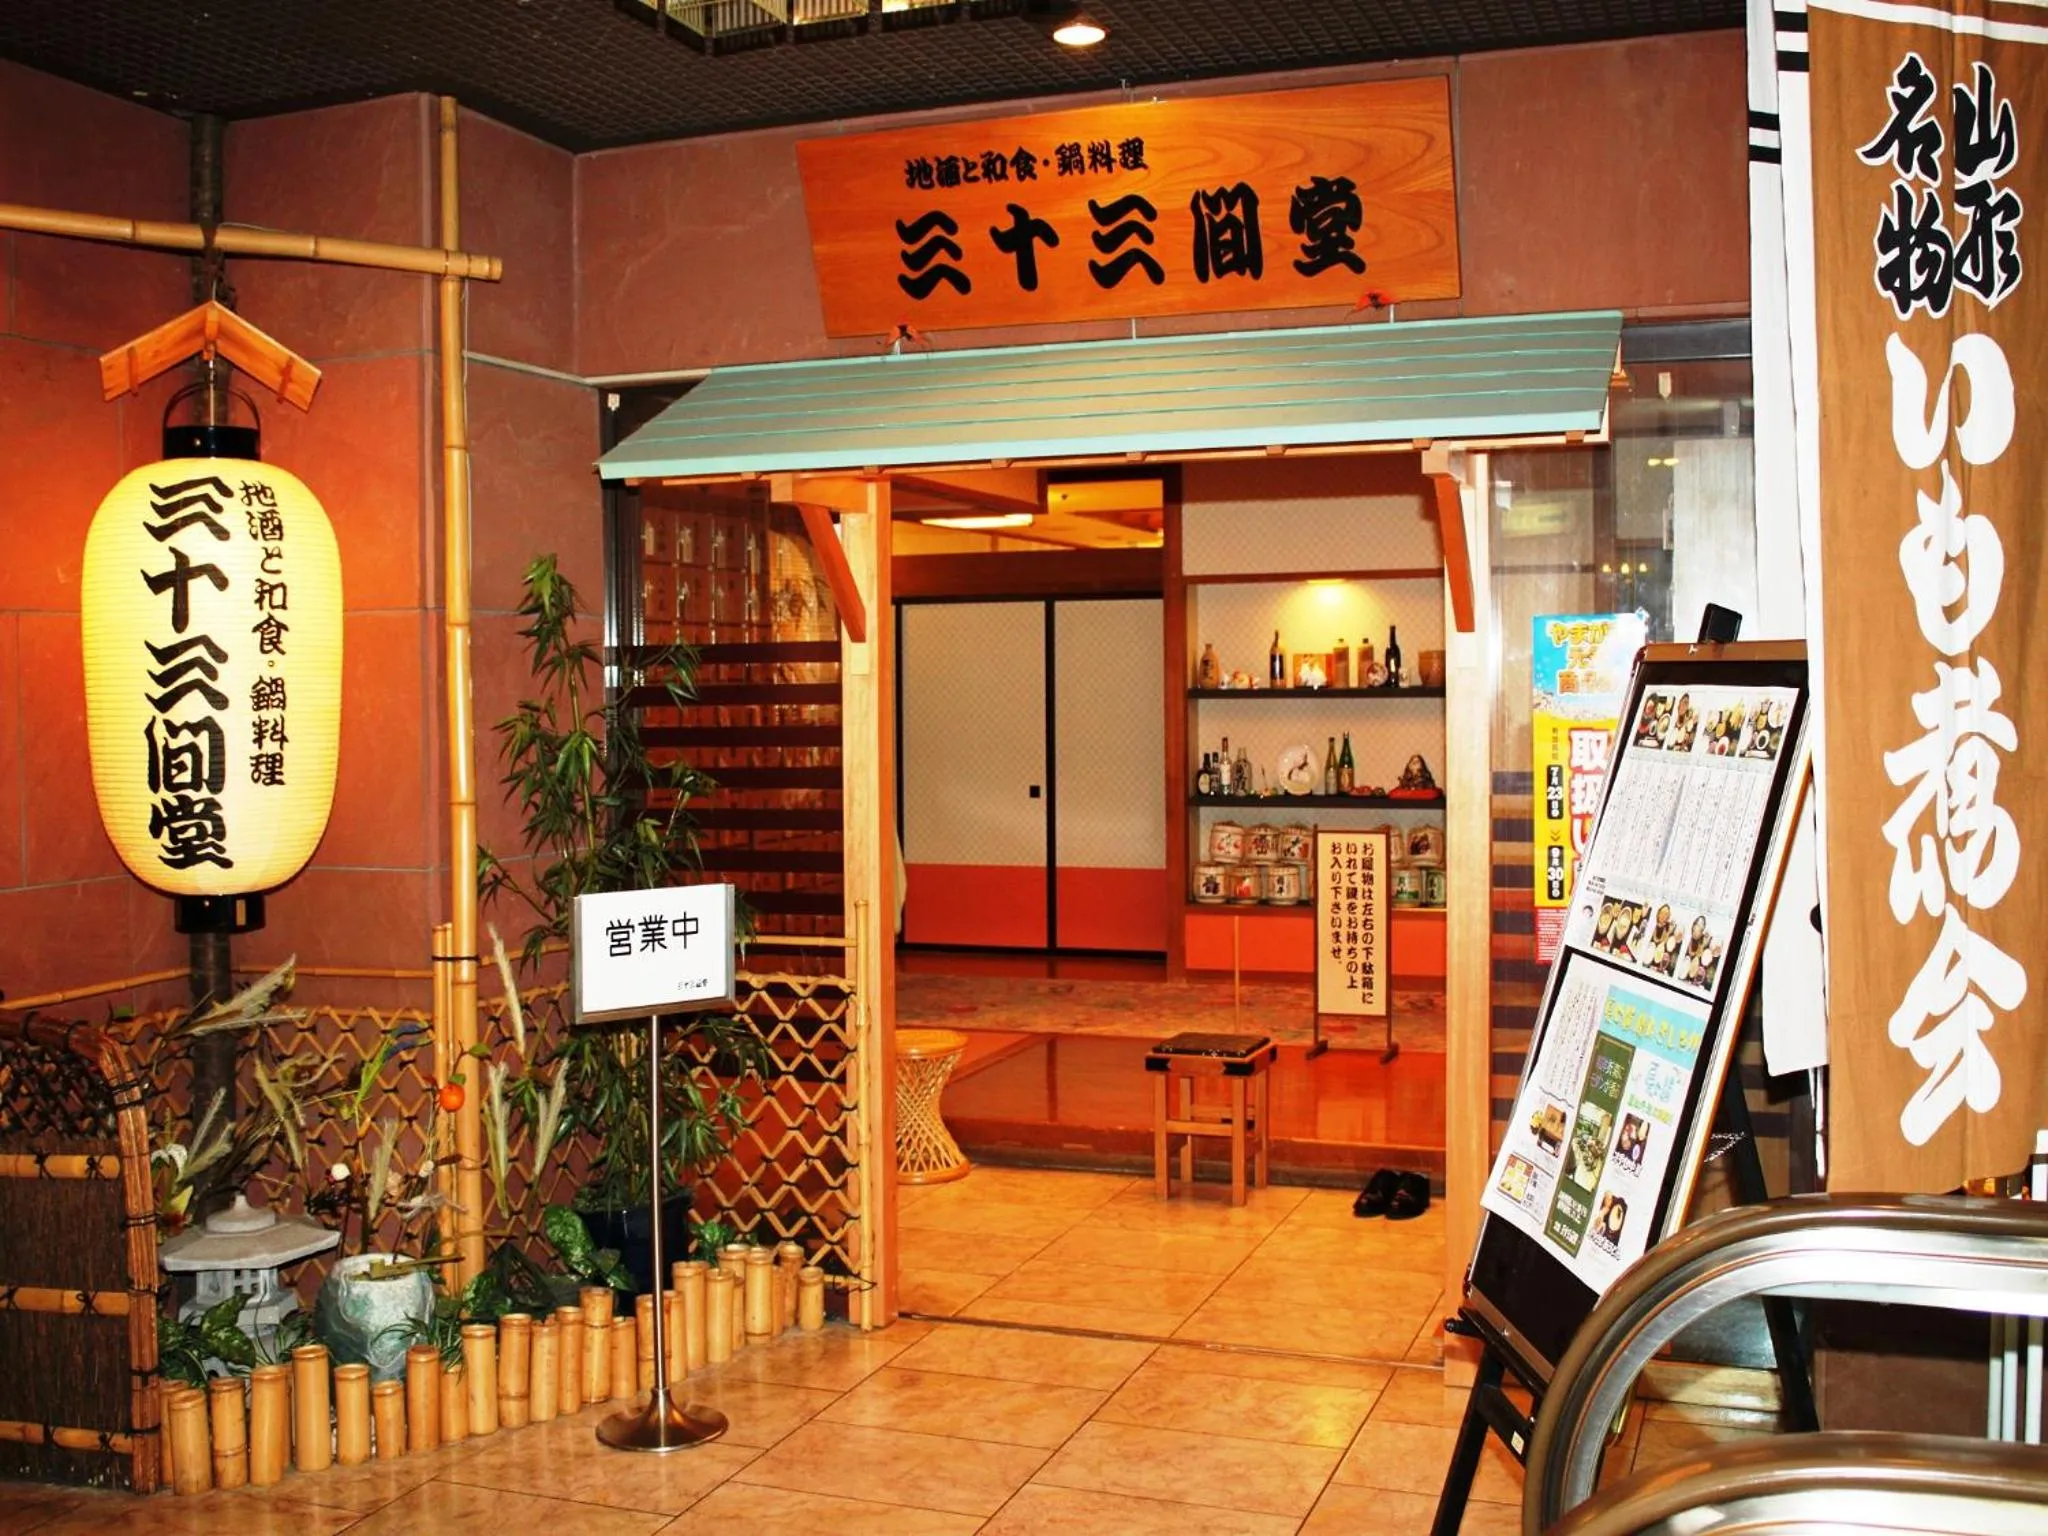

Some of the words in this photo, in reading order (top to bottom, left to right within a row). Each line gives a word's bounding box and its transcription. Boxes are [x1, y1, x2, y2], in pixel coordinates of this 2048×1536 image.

[896, 175, 1367, 300] 三十三間堂
[1856, 52, 1954, 320] 名物
[1953, 61, 2023, 312] 山形
[140, 475, 234, 870] 三十三間堂
[606, 911, 699, 957] 営業中
